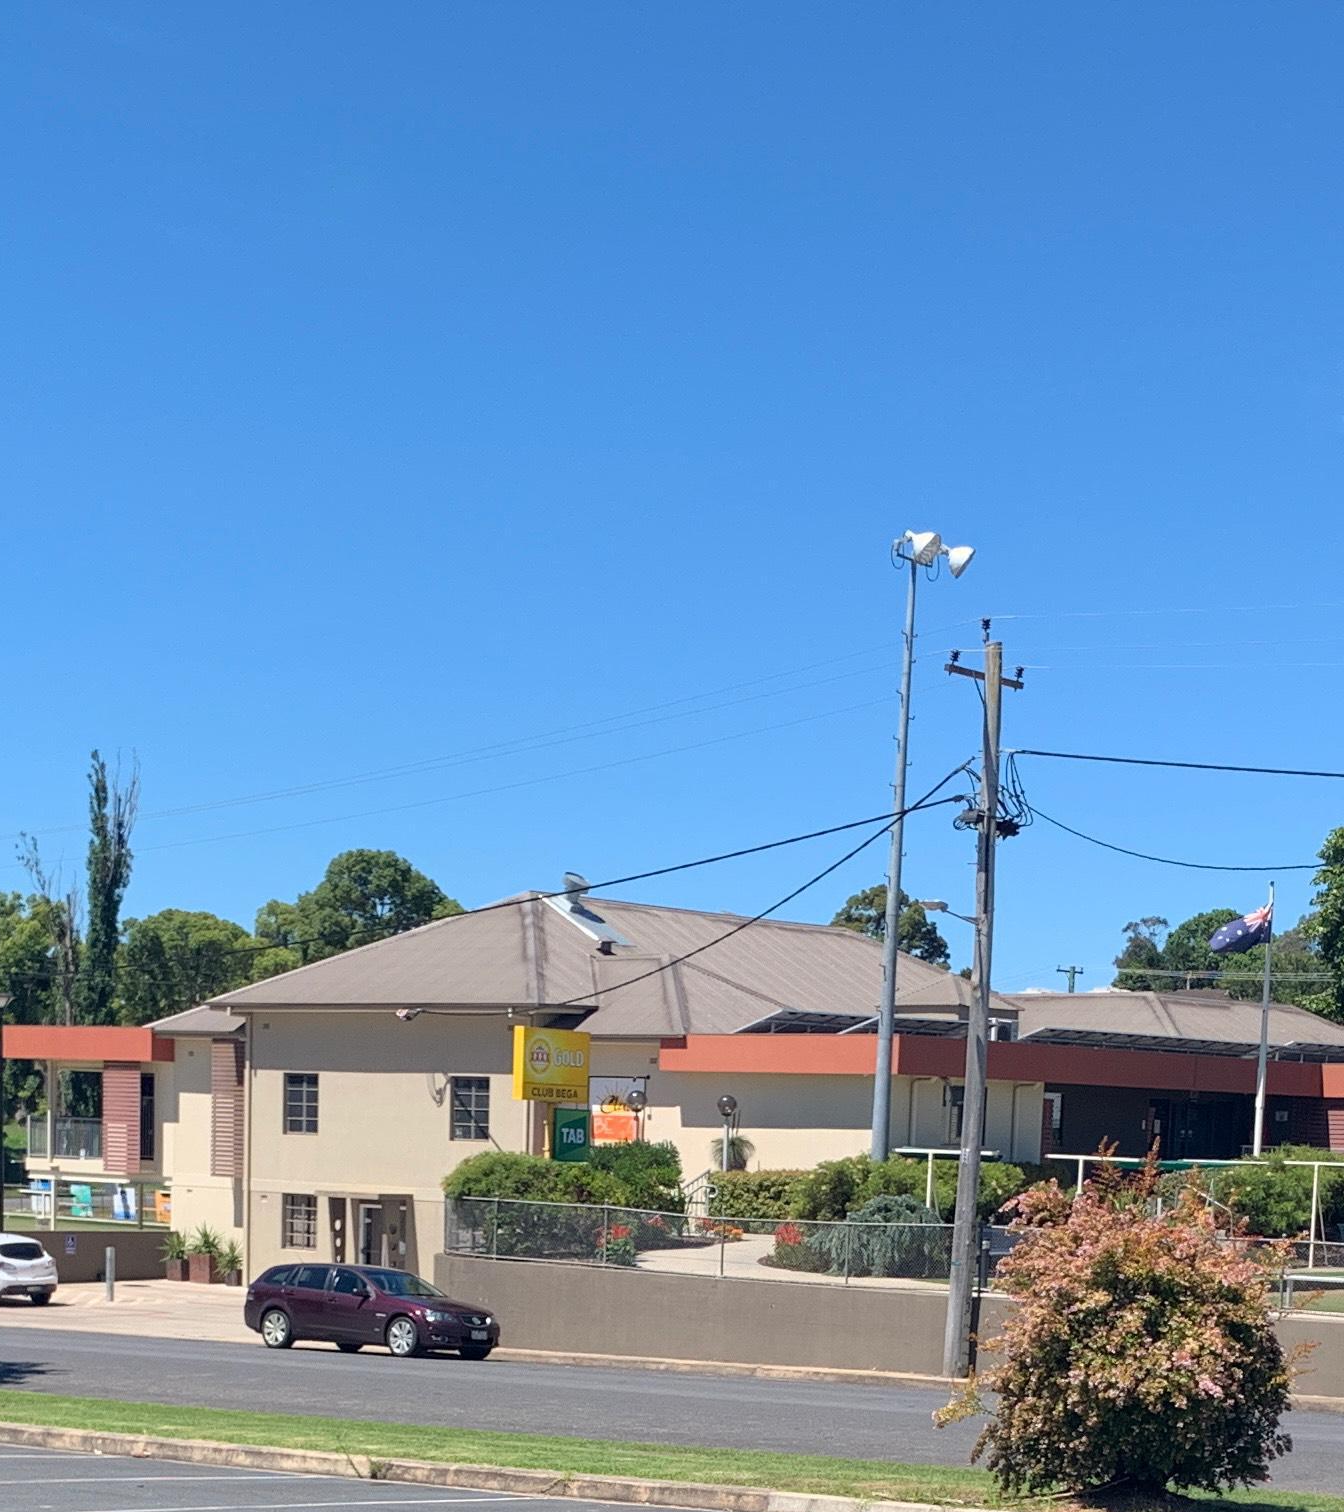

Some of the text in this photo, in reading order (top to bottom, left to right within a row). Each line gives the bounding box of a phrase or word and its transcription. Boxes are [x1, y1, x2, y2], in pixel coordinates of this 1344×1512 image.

[553, 1048, 584, 1067] GOLD
[531, 1087, 579, 1099] CLUB BEGA
[561, 1127, 585, 1144] TAB
